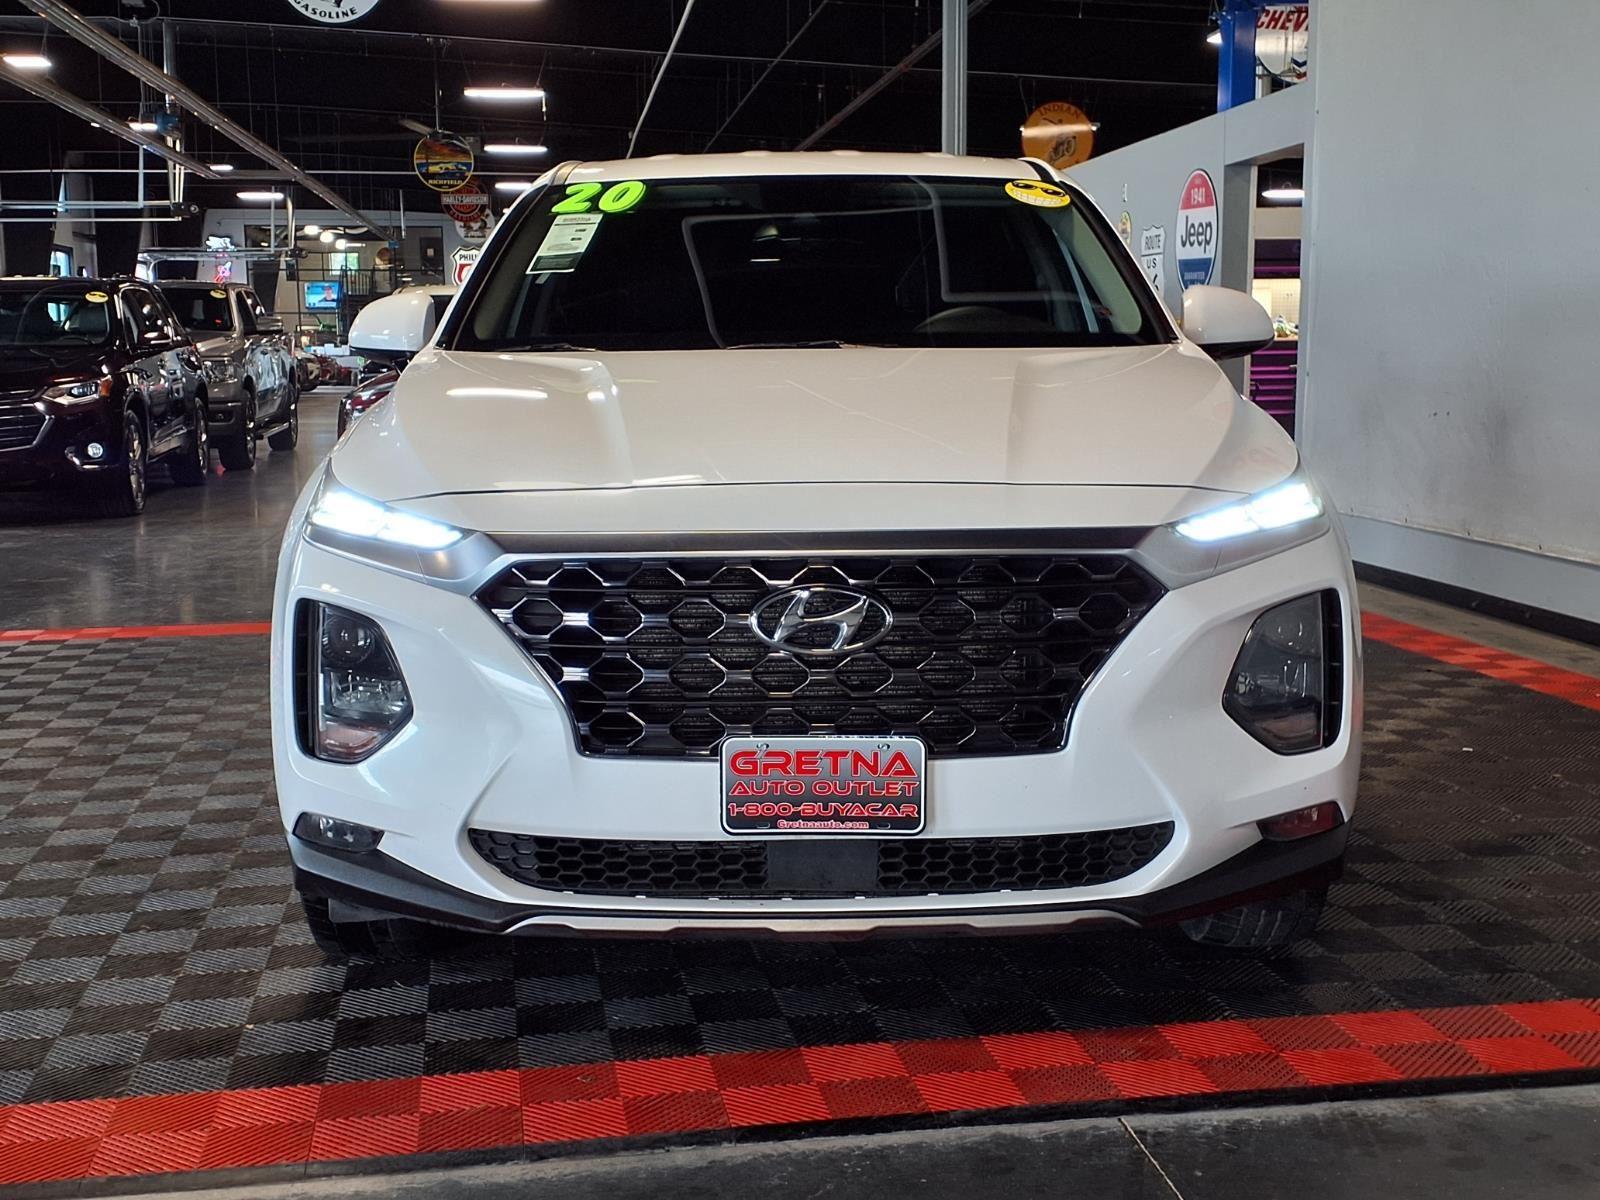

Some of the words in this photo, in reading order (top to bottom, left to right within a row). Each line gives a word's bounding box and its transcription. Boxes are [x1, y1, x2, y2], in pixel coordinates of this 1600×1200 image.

[1256, 6, 1308, 32] CHEV
[1039, 103, 1080, 119] INDIAN
[551, 180, 646, 213] 20
[1191, 187, 1206, 205] 1941
[1145, 234, 1162, 251] ROUTE
[1181, 215, 1213, 254] Jeep
[1146, 257, 1157, 269] US
[729, 749, 918, 778] GRETNA
[729, 780, 805, 796] AUTO
[812, 780, 919, 797] OUTLET
[728, 802, 919, 818] 1-800-BUYACAR
